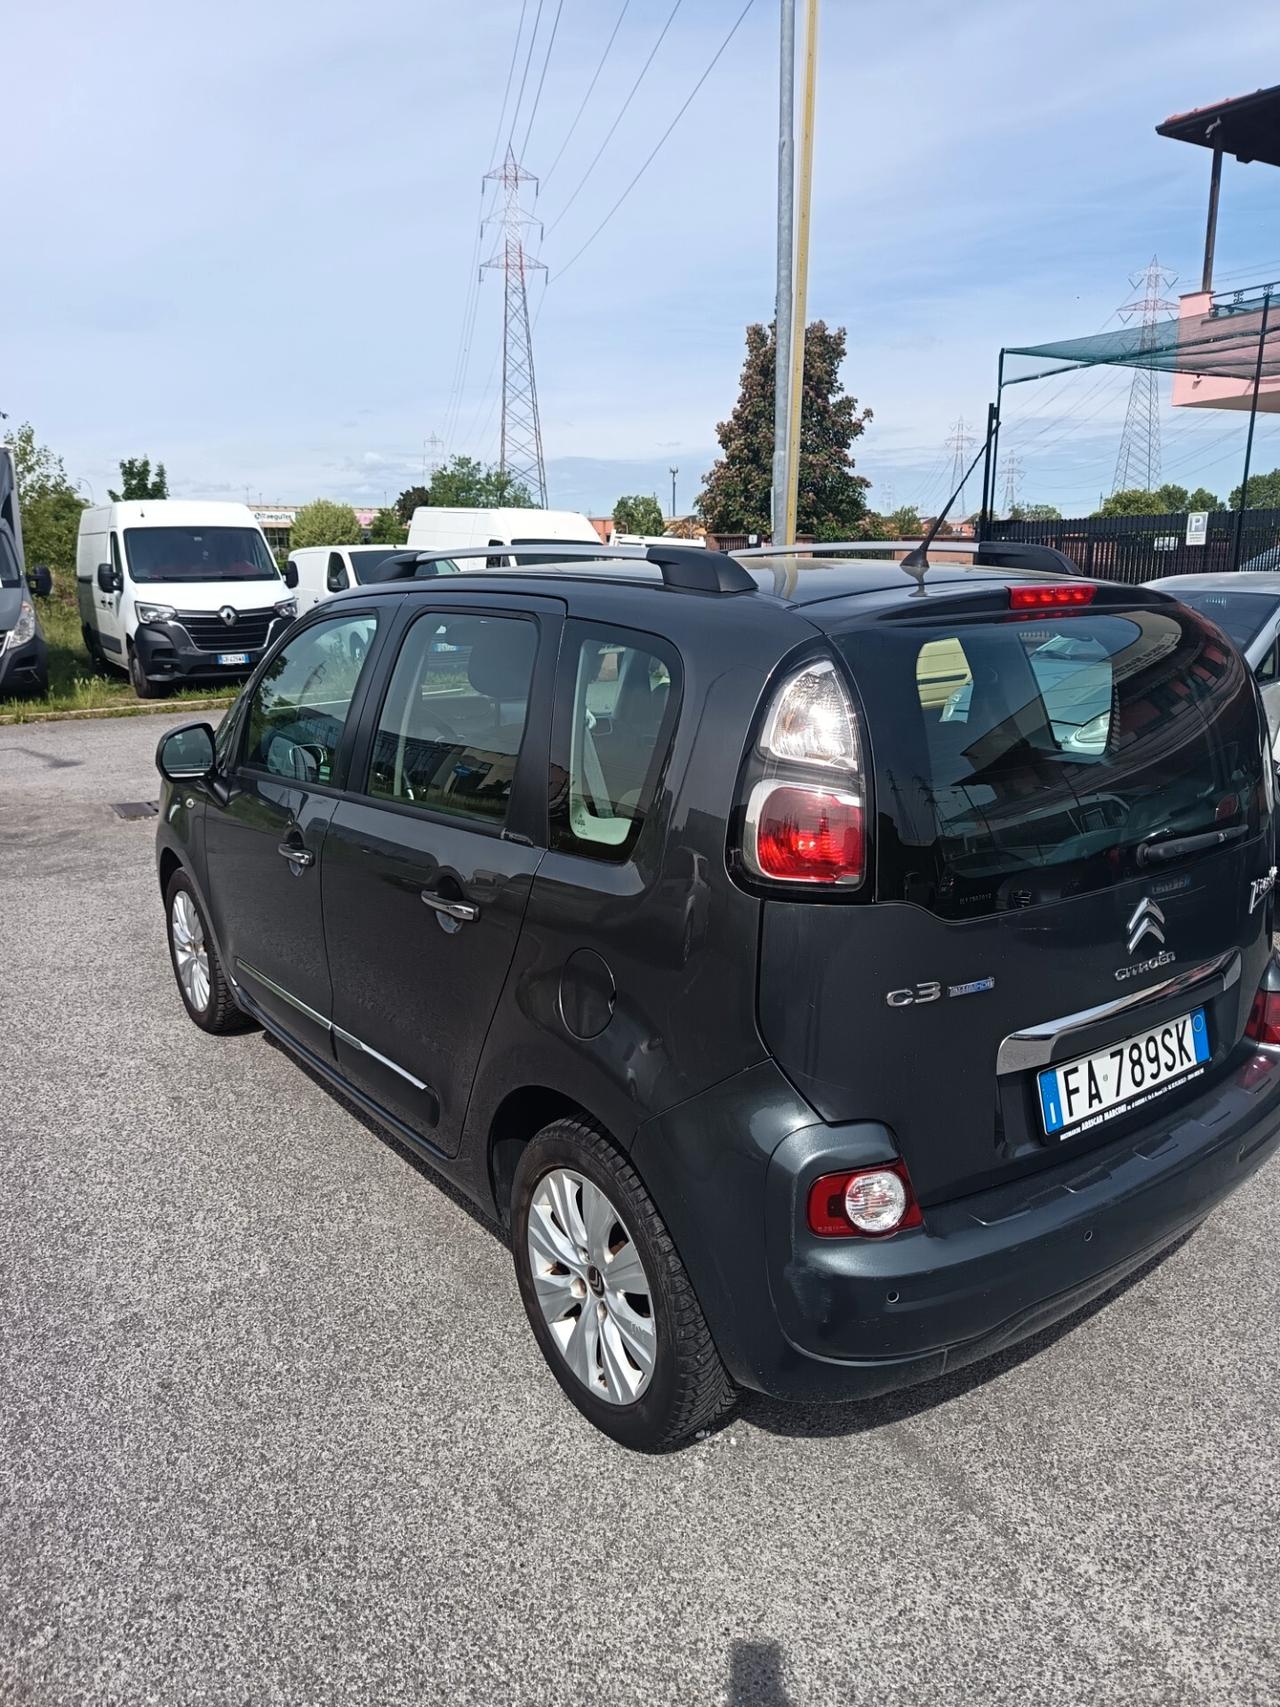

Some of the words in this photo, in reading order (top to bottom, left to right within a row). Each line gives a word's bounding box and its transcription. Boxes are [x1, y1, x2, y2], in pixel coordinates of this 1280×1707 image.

[1191, 516, 1203, 531] P
[886, 981, 941, 1007] C3
[1063, 1060, 1102, 1118] FA
[1109, 1020, 1192, 1097] 789SK
